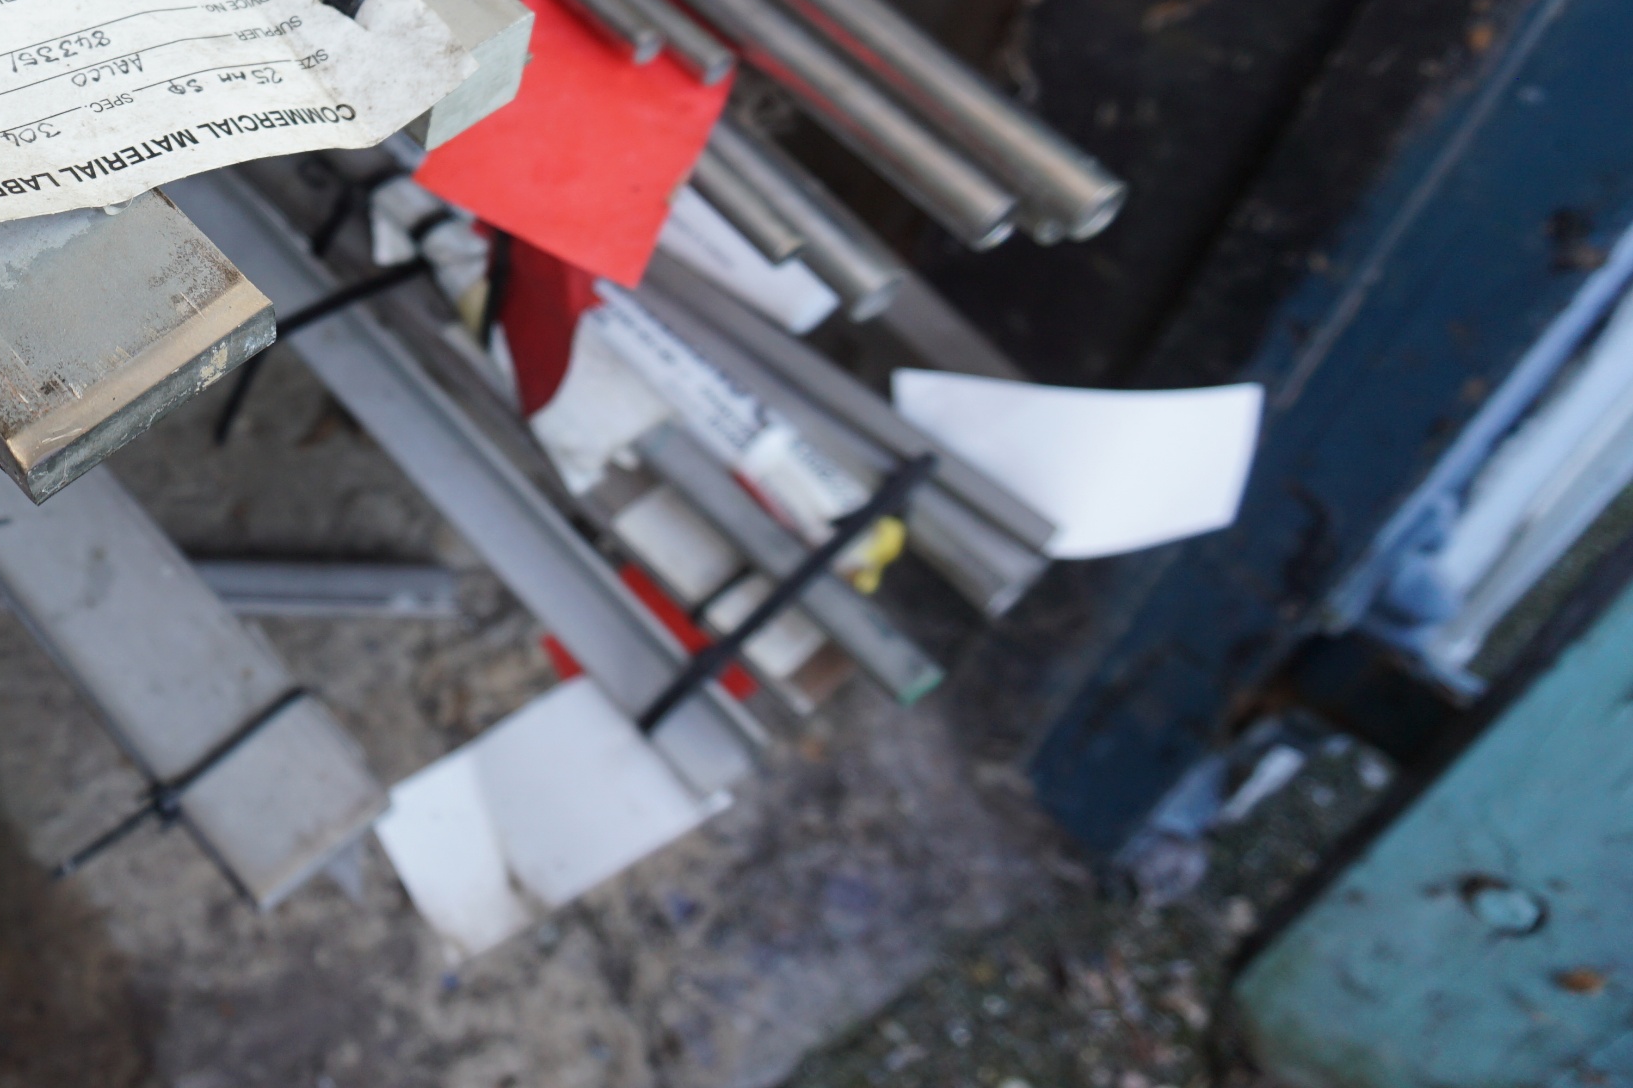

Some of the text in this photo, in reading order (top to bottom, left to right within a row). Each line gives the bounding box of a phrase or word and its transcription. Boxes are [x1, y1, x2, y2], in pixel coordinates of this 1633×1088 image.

[200, 1, 226, 15] No.
[235, 15, 303, 41] SUPPLIER
[65, 49, 144, 88] AALCO
[299, 48, 329, 70] SIZE
[83, 92, 135, 114] SPEC.
[196, 103, 357, 139] COMMERCIAL
[57, 128, 197, 183] MATERIAL
